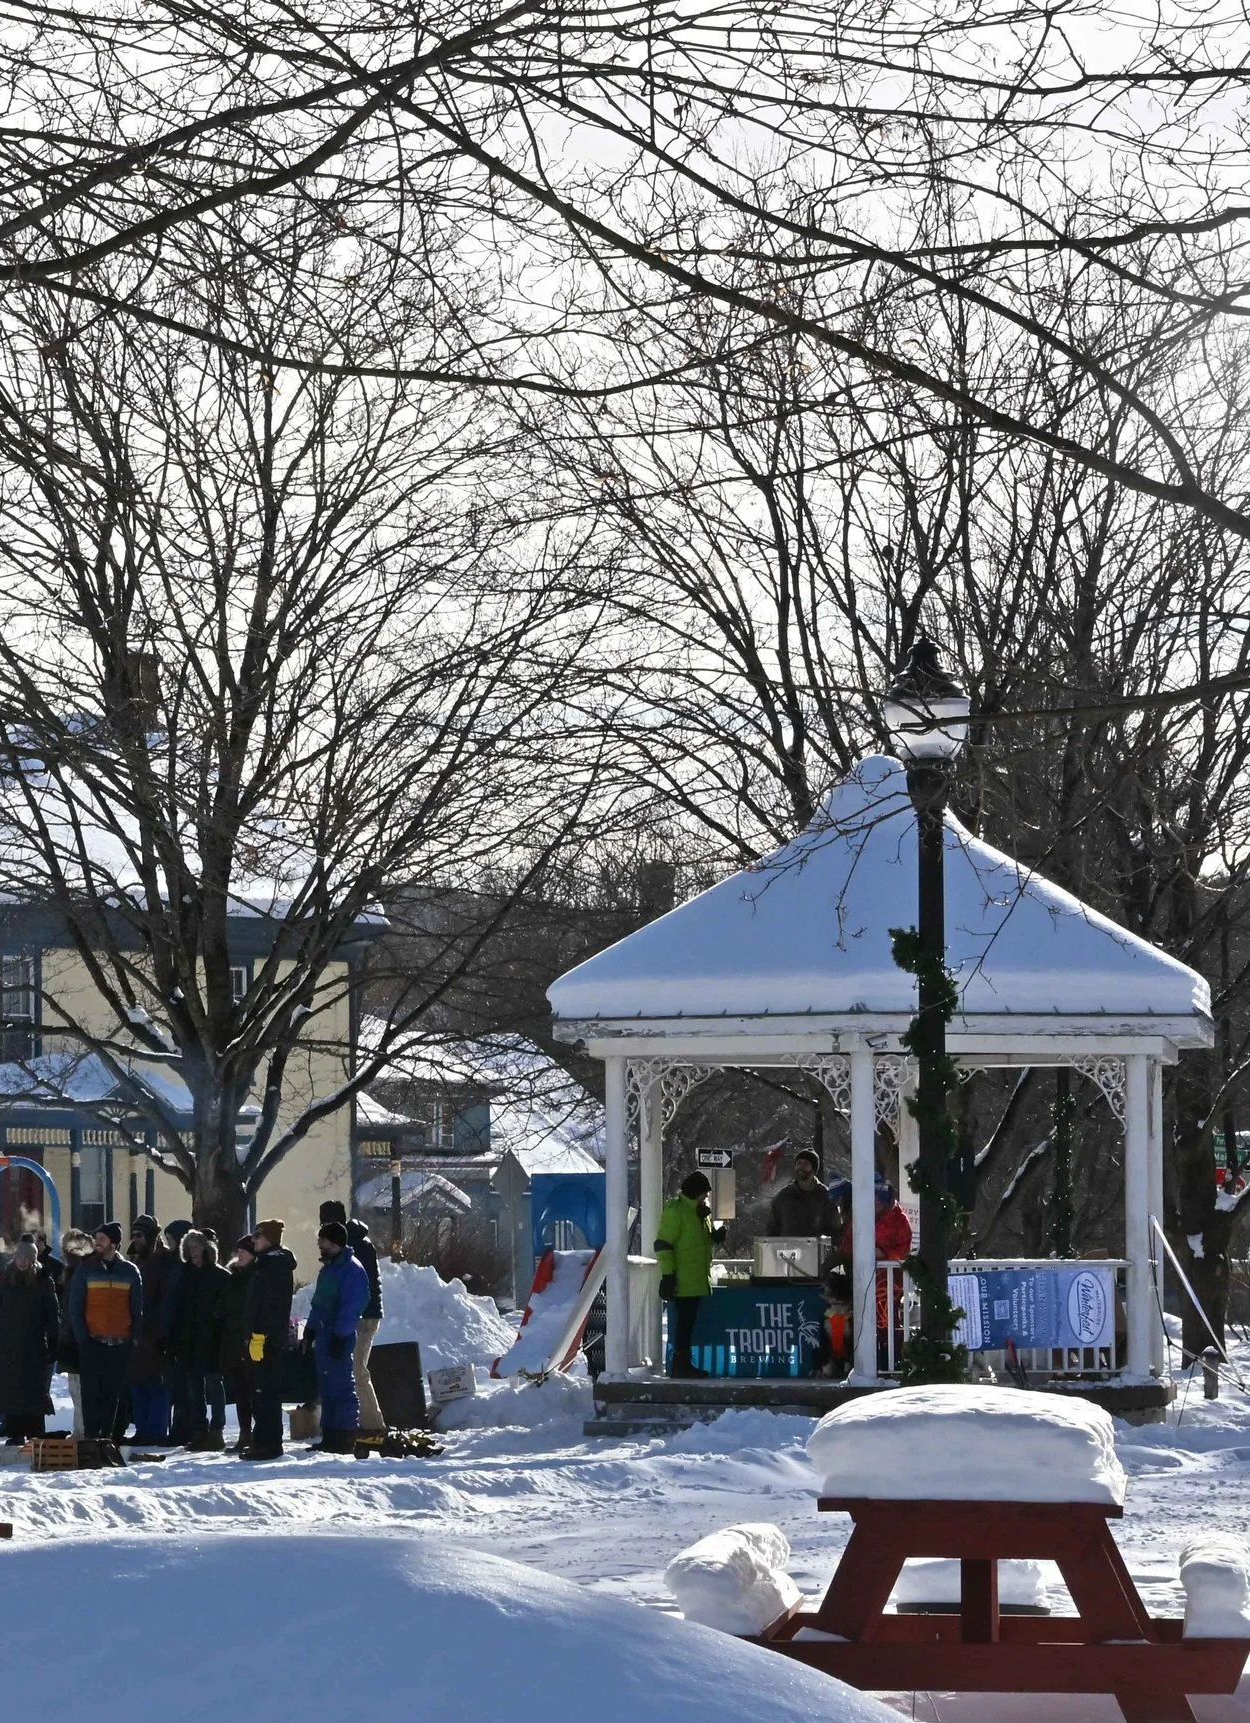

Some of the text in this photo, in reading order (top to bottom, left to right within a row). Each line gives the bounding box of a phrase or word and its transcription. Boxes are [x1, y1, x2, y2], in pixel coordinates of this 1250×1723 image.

[1029, 1276, 1035, 1287] To
[755, 1303, 793, 1327] THE
[980, 1278, 991, 1343] OUR MISSION
[1078, 1278, 1094, 1335] Winterfest
[725, 1329, 795, 1354] TROPIC
[730, 1355, 795, 1364] BREWING
